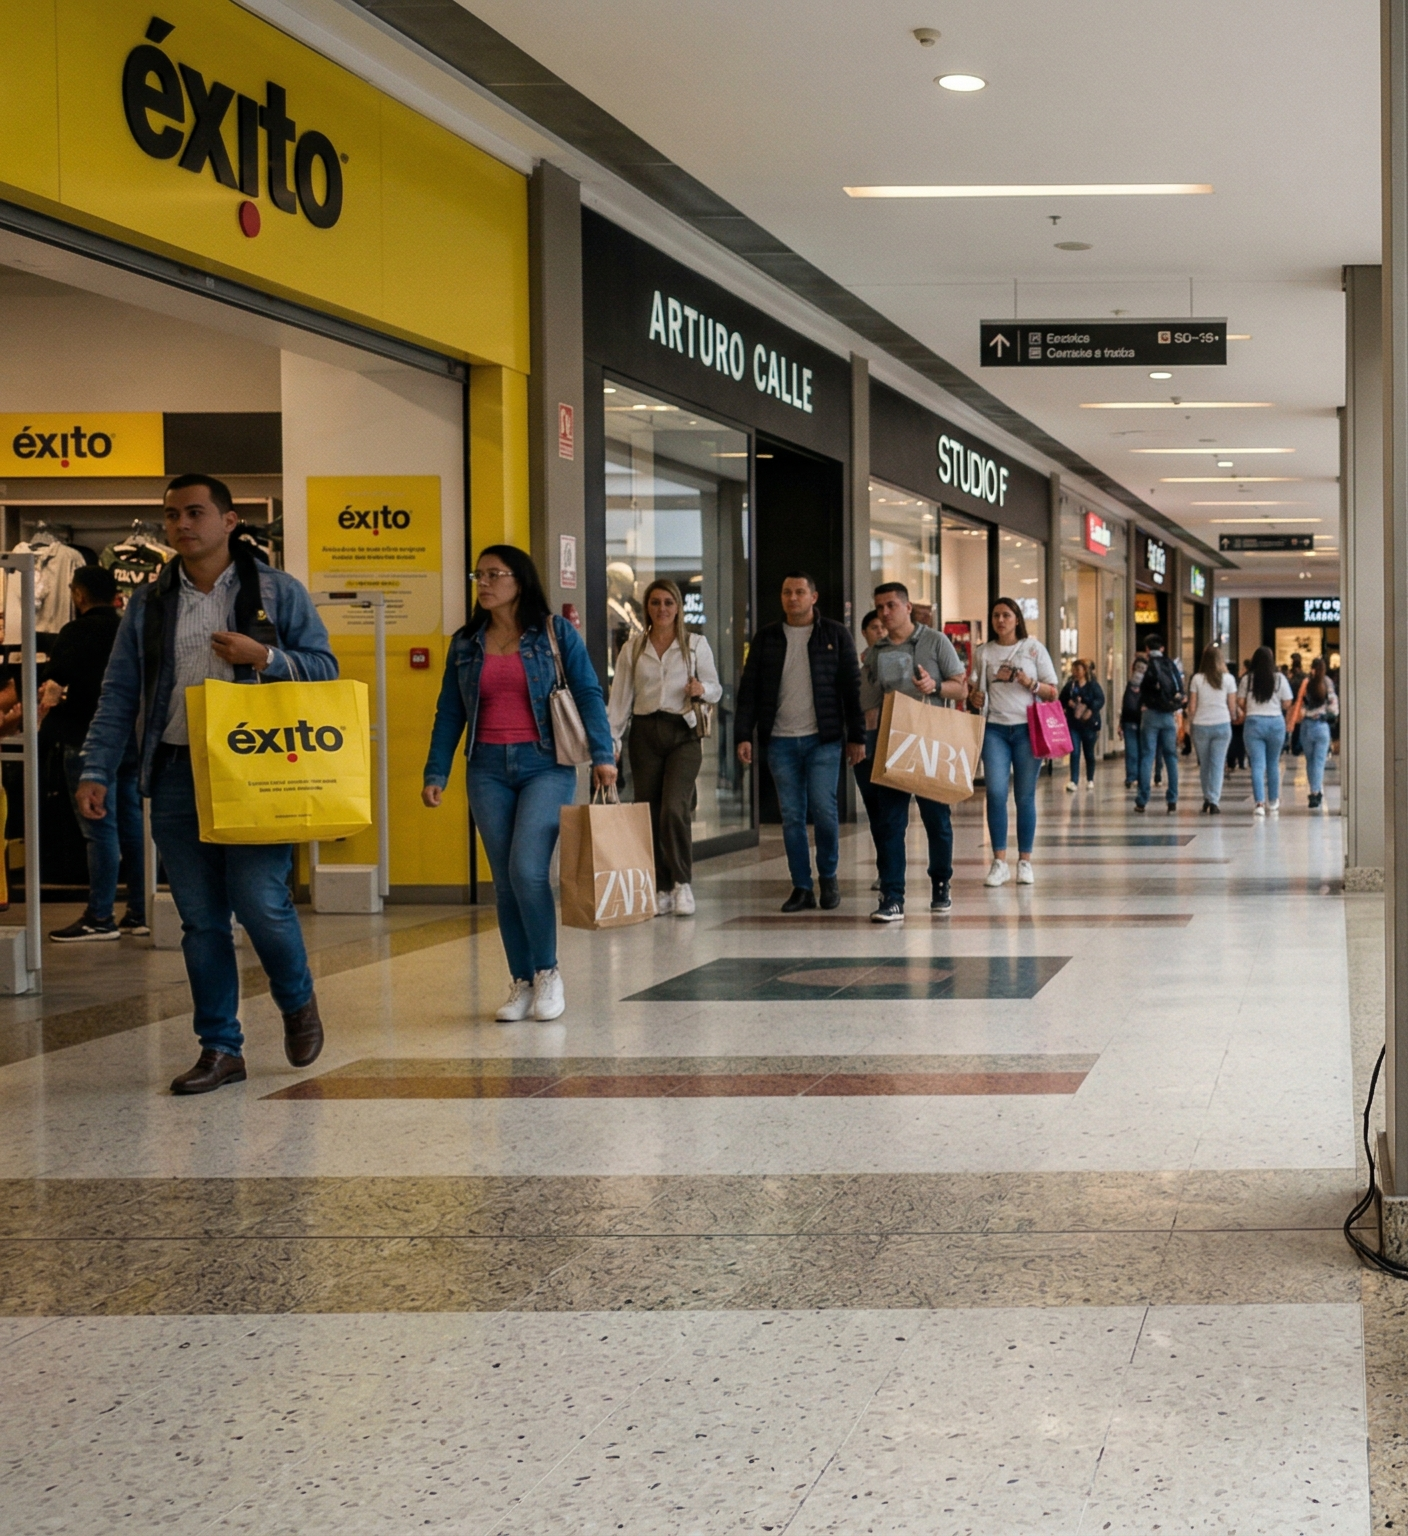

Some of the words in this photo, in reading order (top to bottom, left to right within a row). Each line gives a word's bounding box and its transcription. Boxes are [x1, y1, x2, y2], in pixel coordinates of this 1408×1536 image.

[122, 16, 343, 238] éxito
[649, 290, 745, 382] ARTURO
[753, 343, 813, 414] CALLE
[12, 425, 112, 468] éxito
[938, 434, 998, 504] STUDIO
[1000, 466, 1010, 507] F
[337, 505, 411, 536] éxito
[227, 720, 343, 763] éxito
[885, 728, 974, 793] ZARA
[594, 868, 658, 921] ZARA
